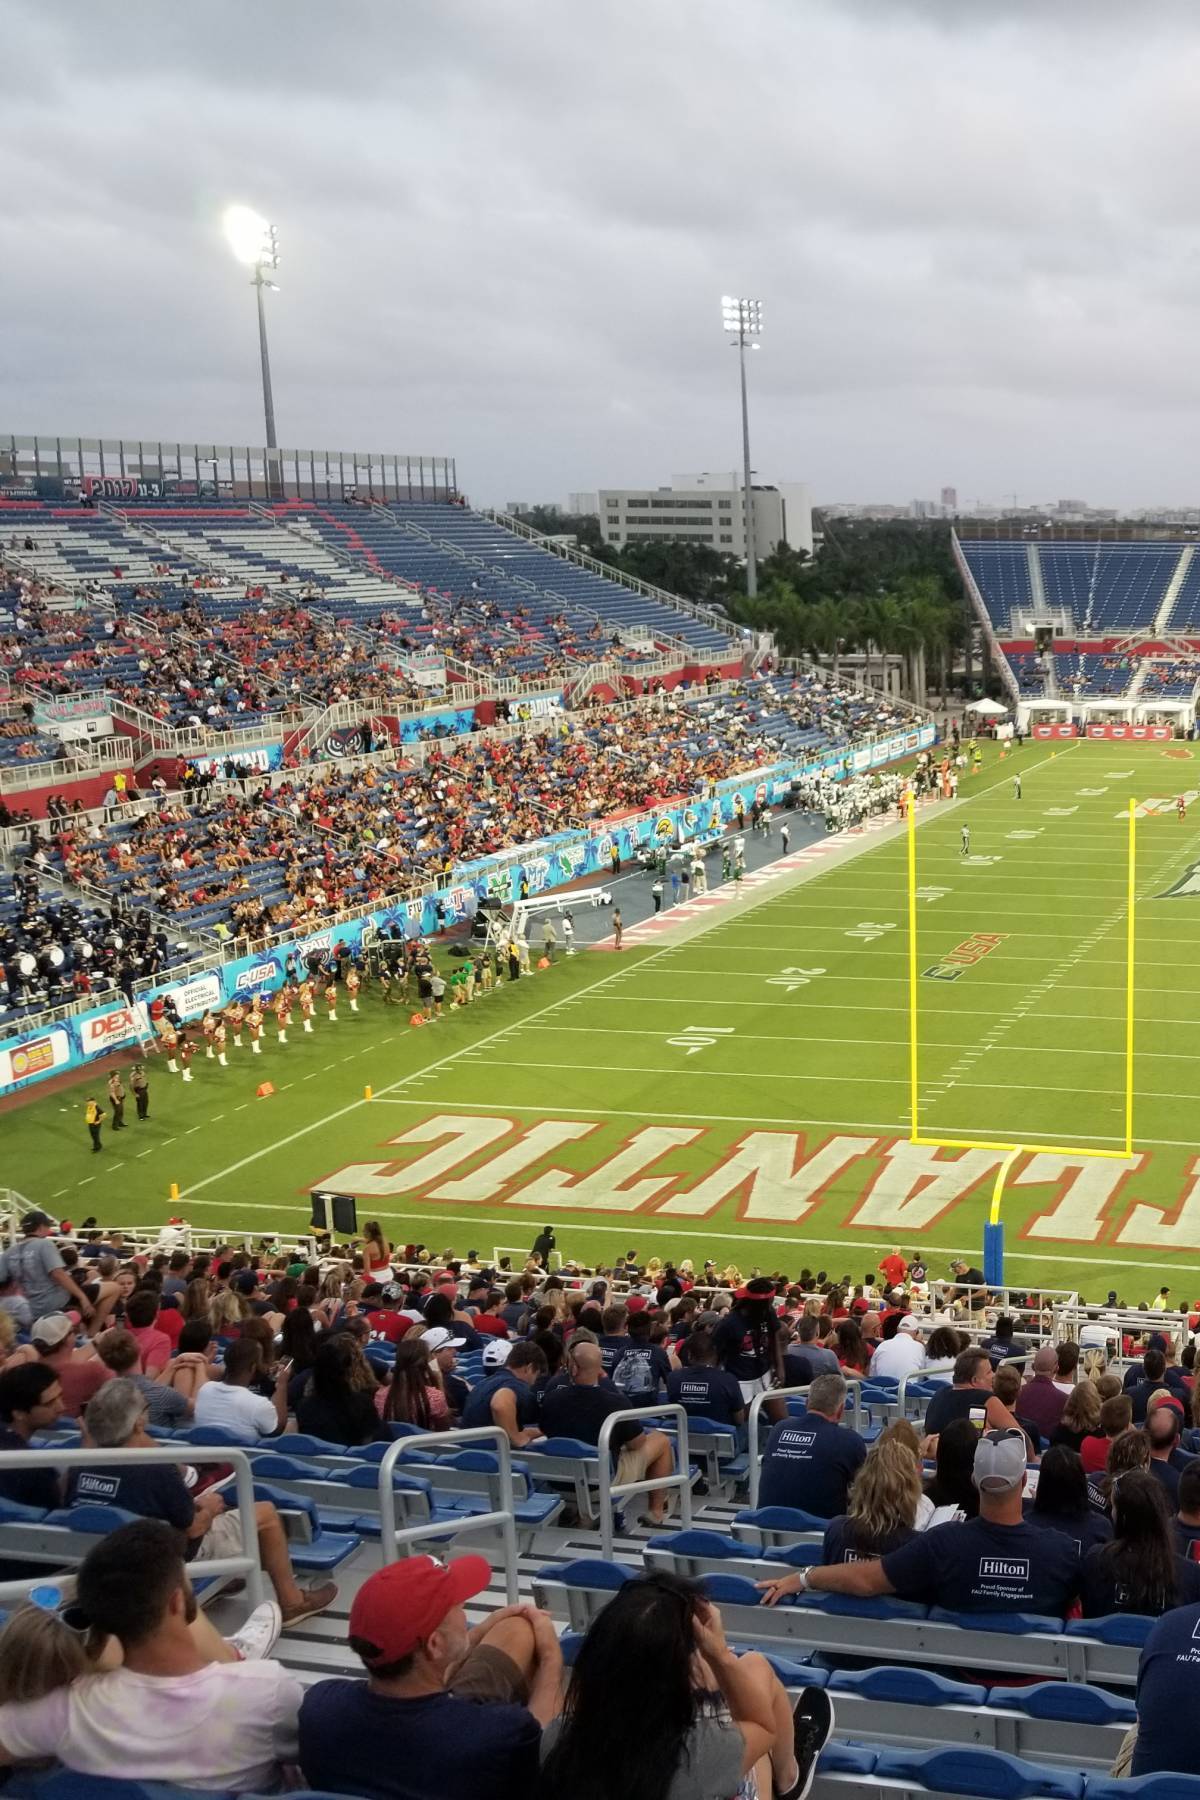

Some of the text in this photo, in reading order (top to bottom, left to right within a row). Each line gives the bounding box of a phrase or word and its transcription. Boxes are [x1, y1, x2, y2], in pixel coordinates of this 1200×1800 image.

[91, 479, 134, 498] 2017
[138, 483, 160, 497] 11-3
[408, 901, 423, 917] FIU
[844, 922, 896, 938] 30
[765, 967, 826, 985] 20
[184, 984, 207, 997] OFFICIAL
[185, 991, 215, 1004] ELECTRICAL
[185, 996, 219, 1012] DISTRIBUTOR
[91, 1009, 133, 1038] DEX
[666, 1025, 735, 1046] 10
[683, 1383, 706, 1392] Hilton
[782, 1432, 812, 1443] Hilton
[80, 1476, 114, 1493] Hilton
[983, 1561, 1025, 1576] Hilton
[983, 1590, 1000, 1598] Family
[997, 1585, 1017, 1593] Sponsor
[1176, 1654, 1192, 1662] FAU
